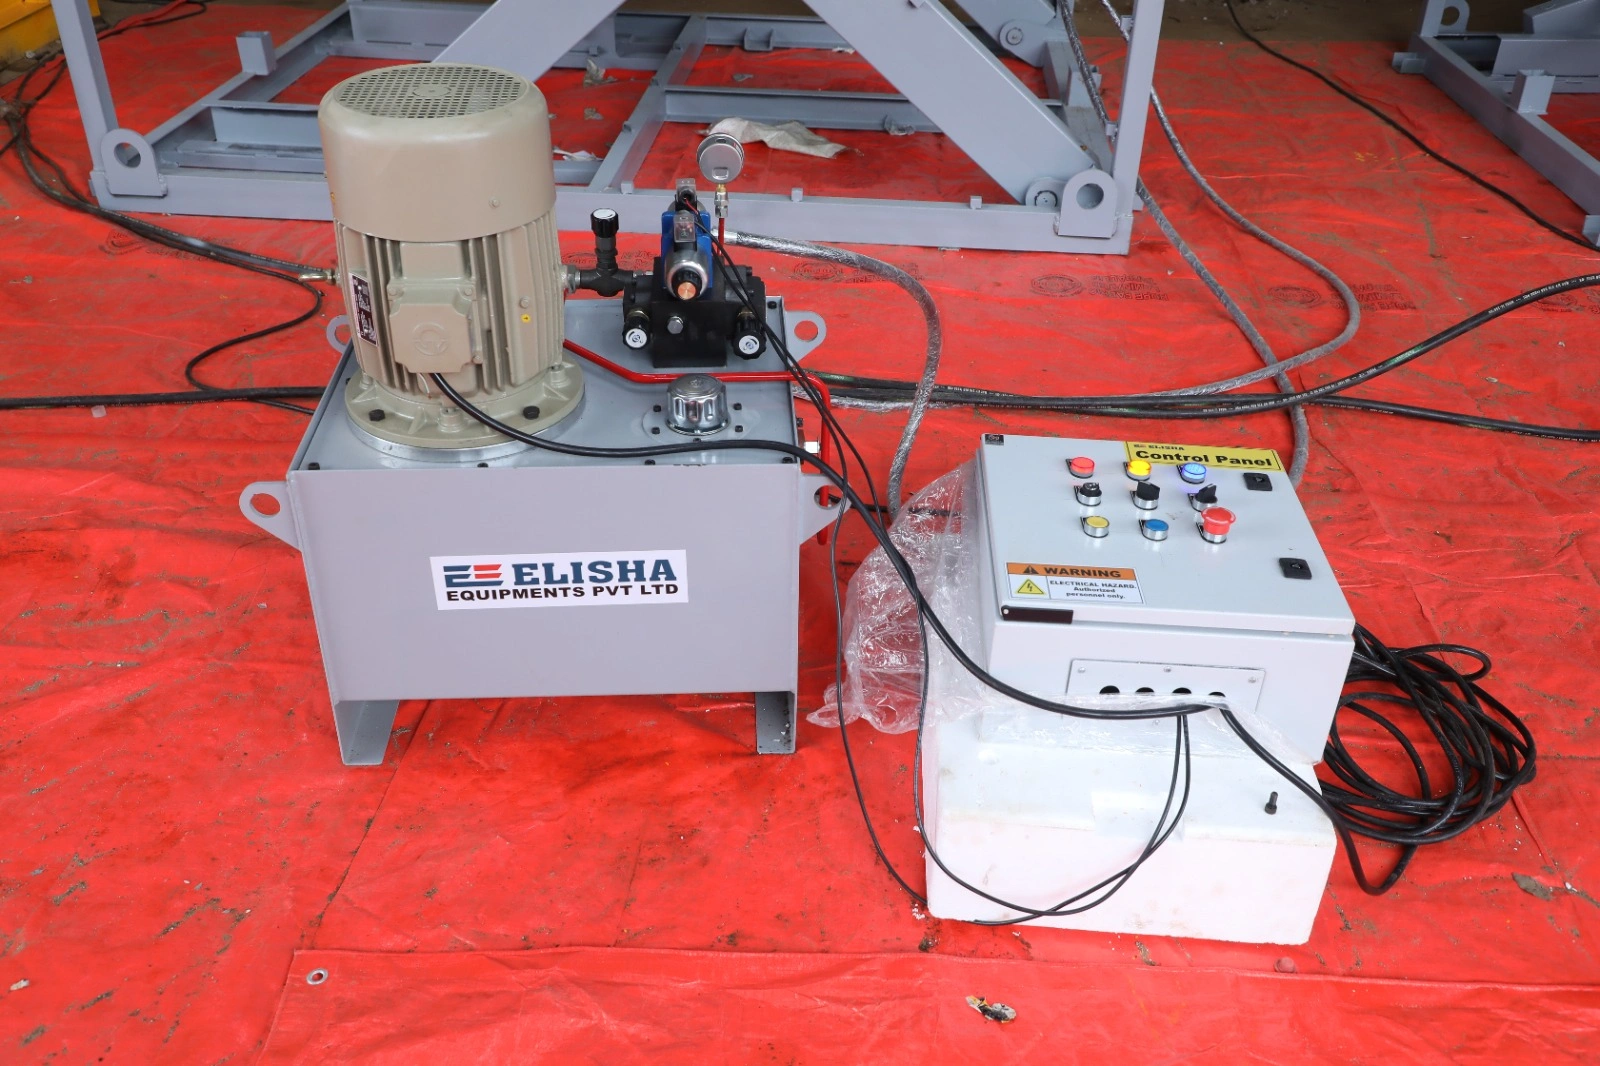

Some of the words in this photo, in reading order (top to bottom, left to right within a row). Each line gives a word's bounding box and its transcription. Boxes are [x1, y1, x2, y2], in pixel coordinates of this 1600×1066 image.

[1135, 450, 1209, 463] Control
[1215, 455, 1272, 466] Panel
[512, 559, 677, 586] ELISHA
[1044, 567, 1122, 578] WARNING
[446, 586, 585, 602] EQUIPMENTS
[592, 585, 633, 597] PVT
[640, 584, 679, 595] LTD
